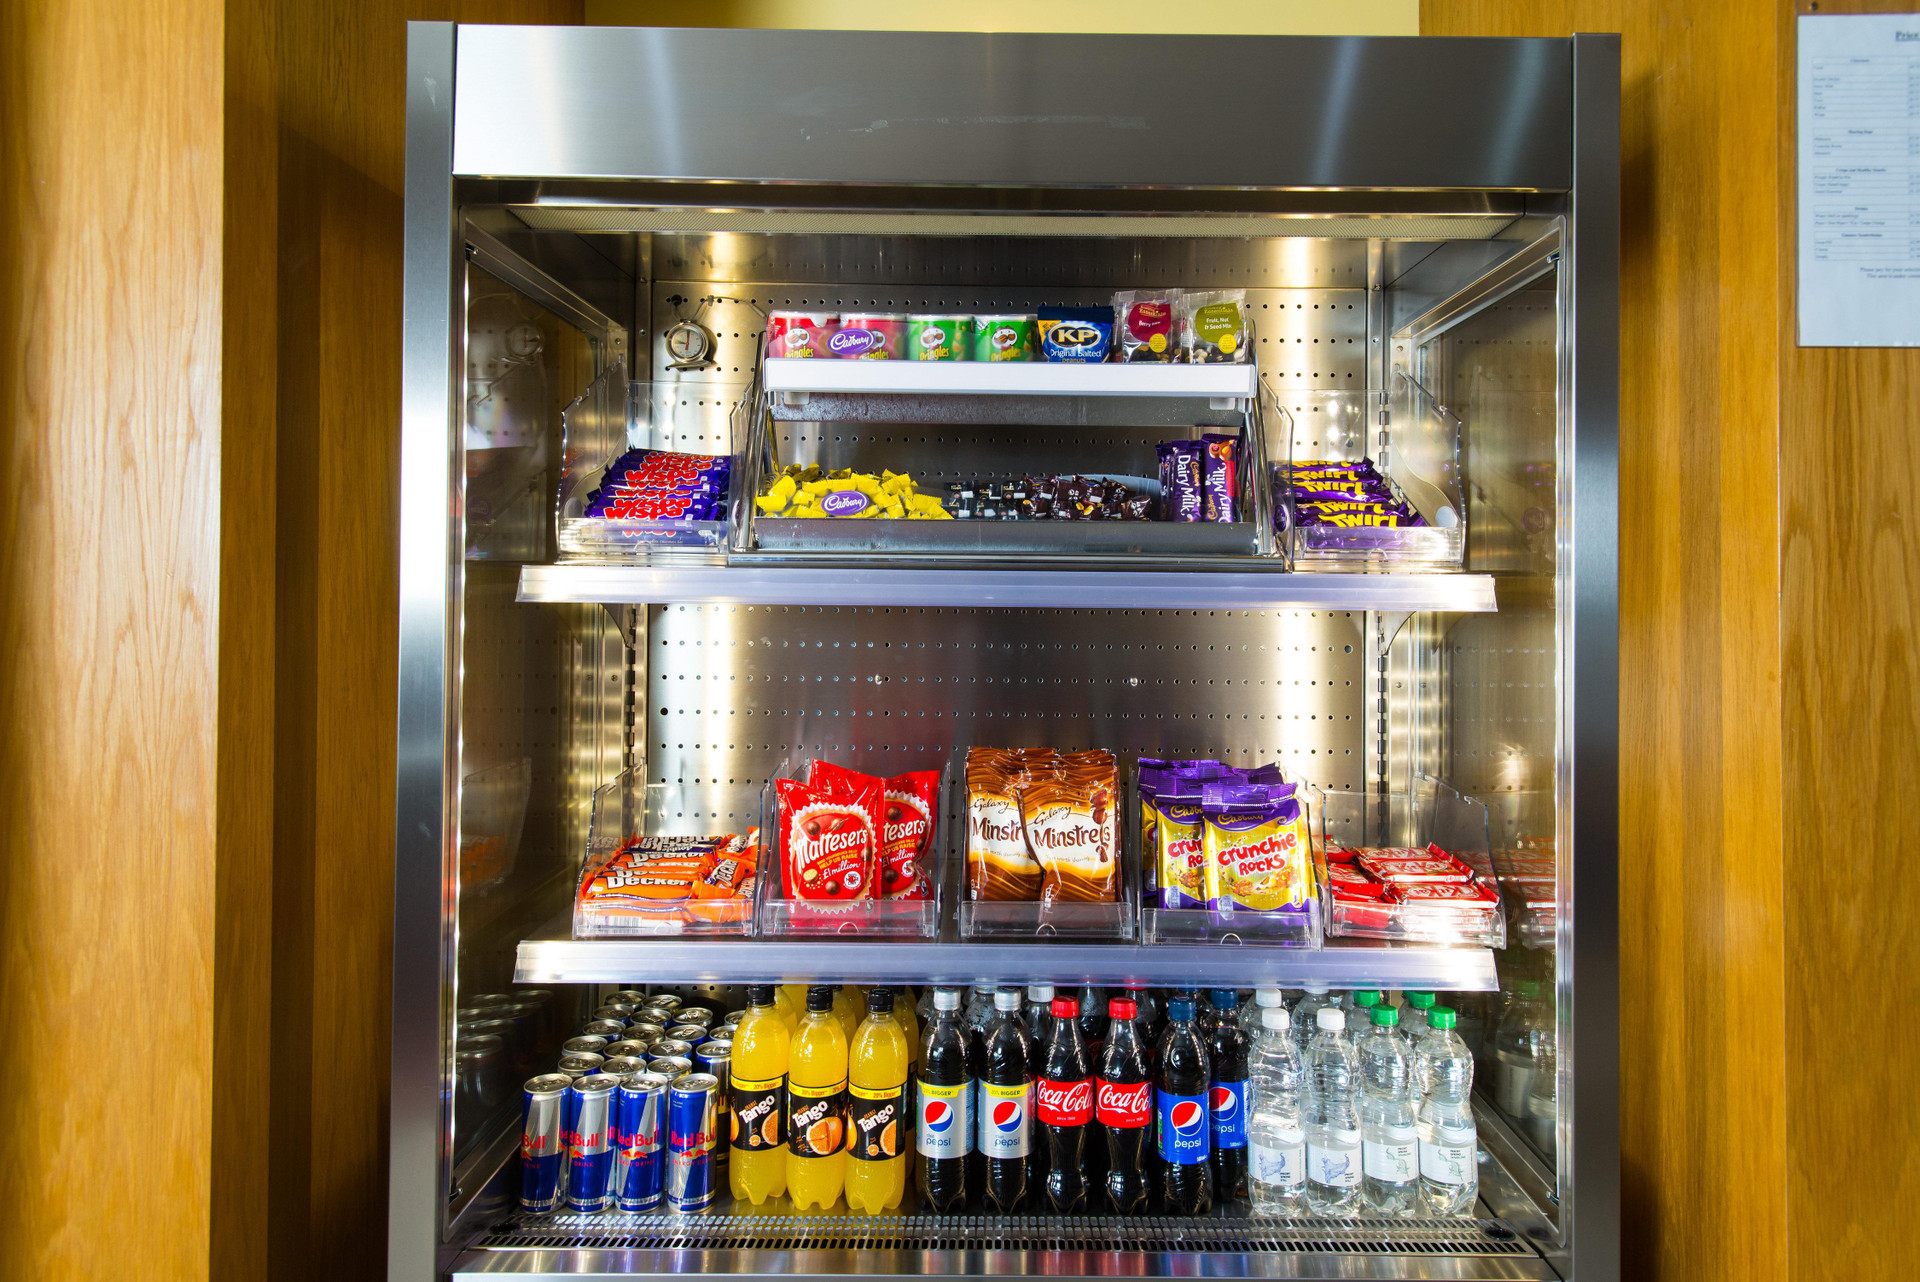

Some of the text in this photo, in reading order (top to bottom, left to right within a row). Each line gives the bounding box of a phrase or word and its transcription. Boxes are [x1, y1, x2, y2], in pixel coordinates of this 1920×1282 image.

[829, 331, 873, 350] Cadbury
[1058, 329, 1095, 342] KP
[1050, 349, 1076, 358] Original
[625, 470, 698, 485] Wispa
[1176, 455, 1196, 516] Dairy Milk
[1213, 462, 1227, 492] Milk
[824, 494, 867, 512] Cadbury
[1207, 494, 1218, 520] Cadbury
[604, 507, 684, 520] Wispa
[1318, 513, 1398, 530] Twirl
[972, 798, 1010, 814] Galaxy
[1170, 805, 1203, 818] Cadbu
[1033, 805, 1071, 826] Galaxy
[1217, 814, 1264, 825] Cadbury
[883, 819, 925, 843] tesers
[972, 816, 1022, 842] Minstr
[1034, 823, 1111, 849] Minstrels
[794, 829, 867, 874] Maltesers
[890, 848, 917, 864] million
[1168, 839, 1203, 858] Crun
[1217, 833, 1297, 866] Crunchie
[819, 860, 832, 869] HELP
[831, 859, 861, 875] million
[606, 876, 690, 889] Decker
[1037, 1080, 1092, 1112] Coca-Cola
[739, 1095, 775, 1124] Tango
[792, 1101, 828, 1128] Tango
[857, 1104, 894, 1132] Tango
[523, 1134, 546, 1150] Bull
[574, 1131, 599, 1147] Bull
[635, 1124, 659, 1146] Bull
[671, 1130, 694, 1147] Red
[926, 1137, 951, 1147] pepsi
[995, 1137, 1020, 1147] pepsi
[1174, 1137, 1202, 1149] pepsi
[671, 1158, 694, 1167] ENERGY
